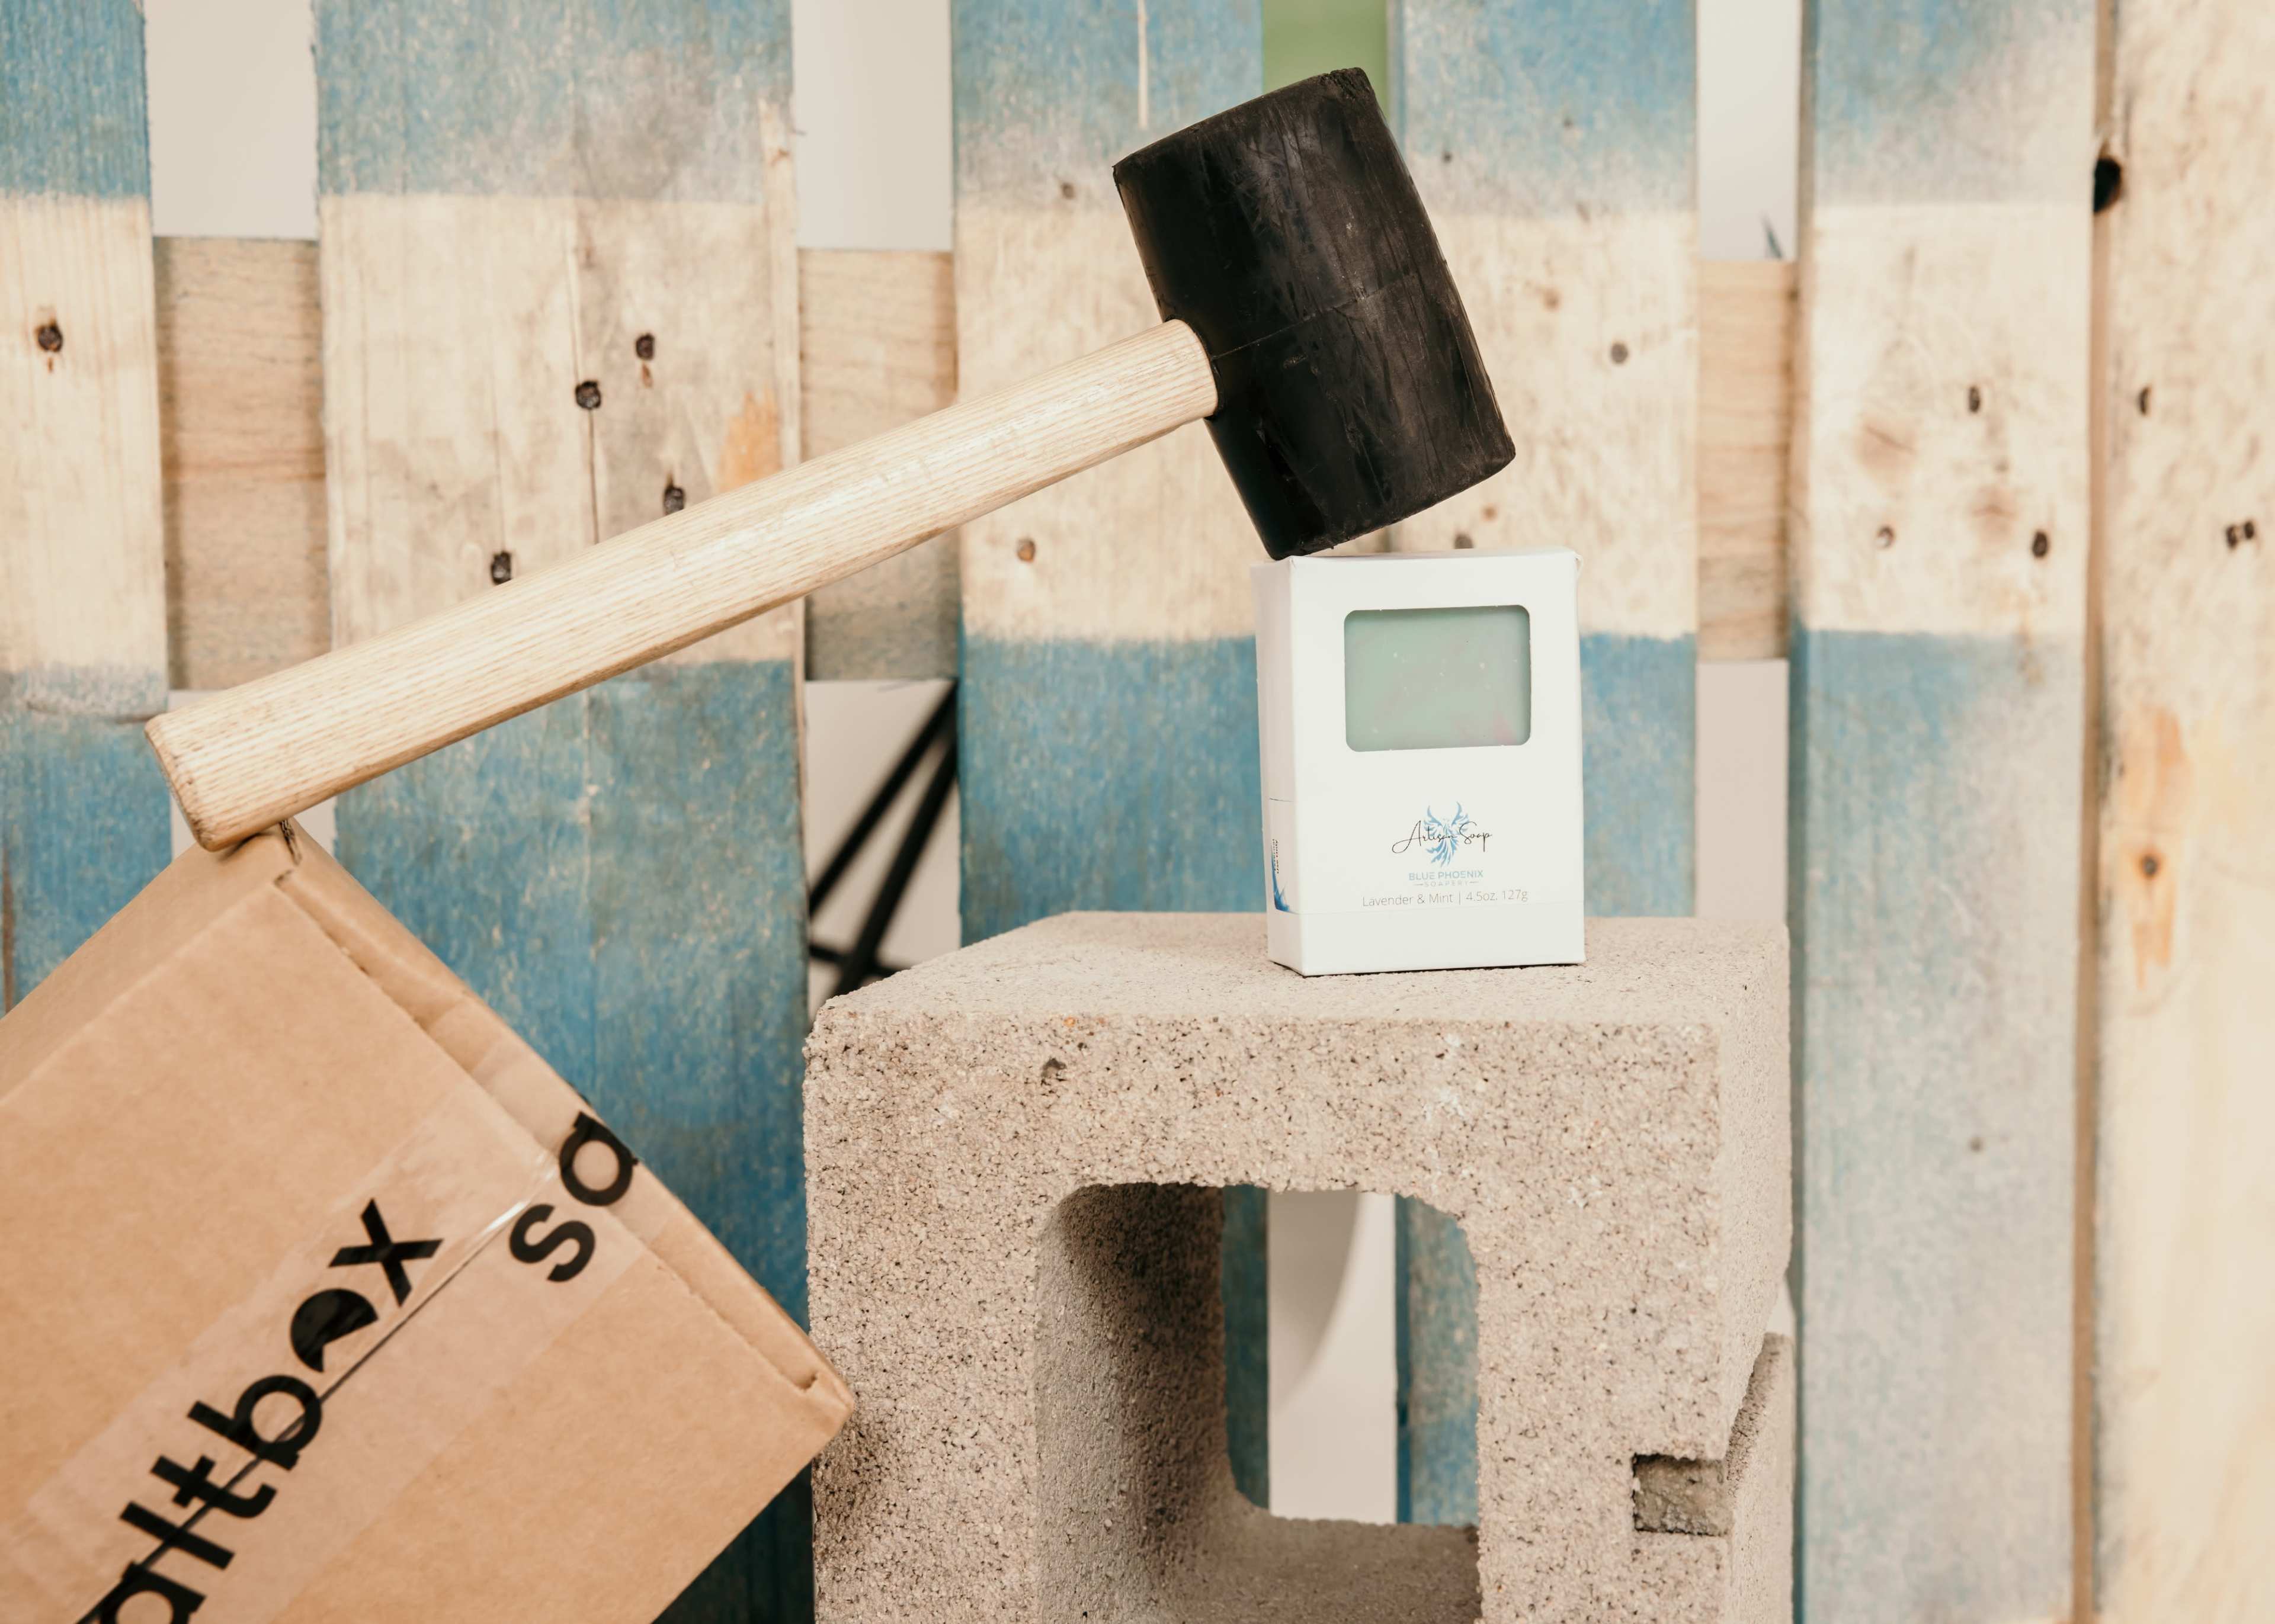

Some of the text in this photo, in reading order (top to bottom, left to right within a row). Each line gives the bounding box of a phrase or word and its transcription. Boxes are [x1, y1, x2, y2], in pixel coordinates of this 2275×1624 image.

[1392, 820, 1492, 853] Artisan Soap
[1408, 870, 1483, 881] BLUE PHOENIX
[1362, 894, 1413, 907] Lavender
[1417, 893, 1425, 904] &
[1428, 893, 1453, 904] Mint
[1502, 889, 1529, 902] 127g
